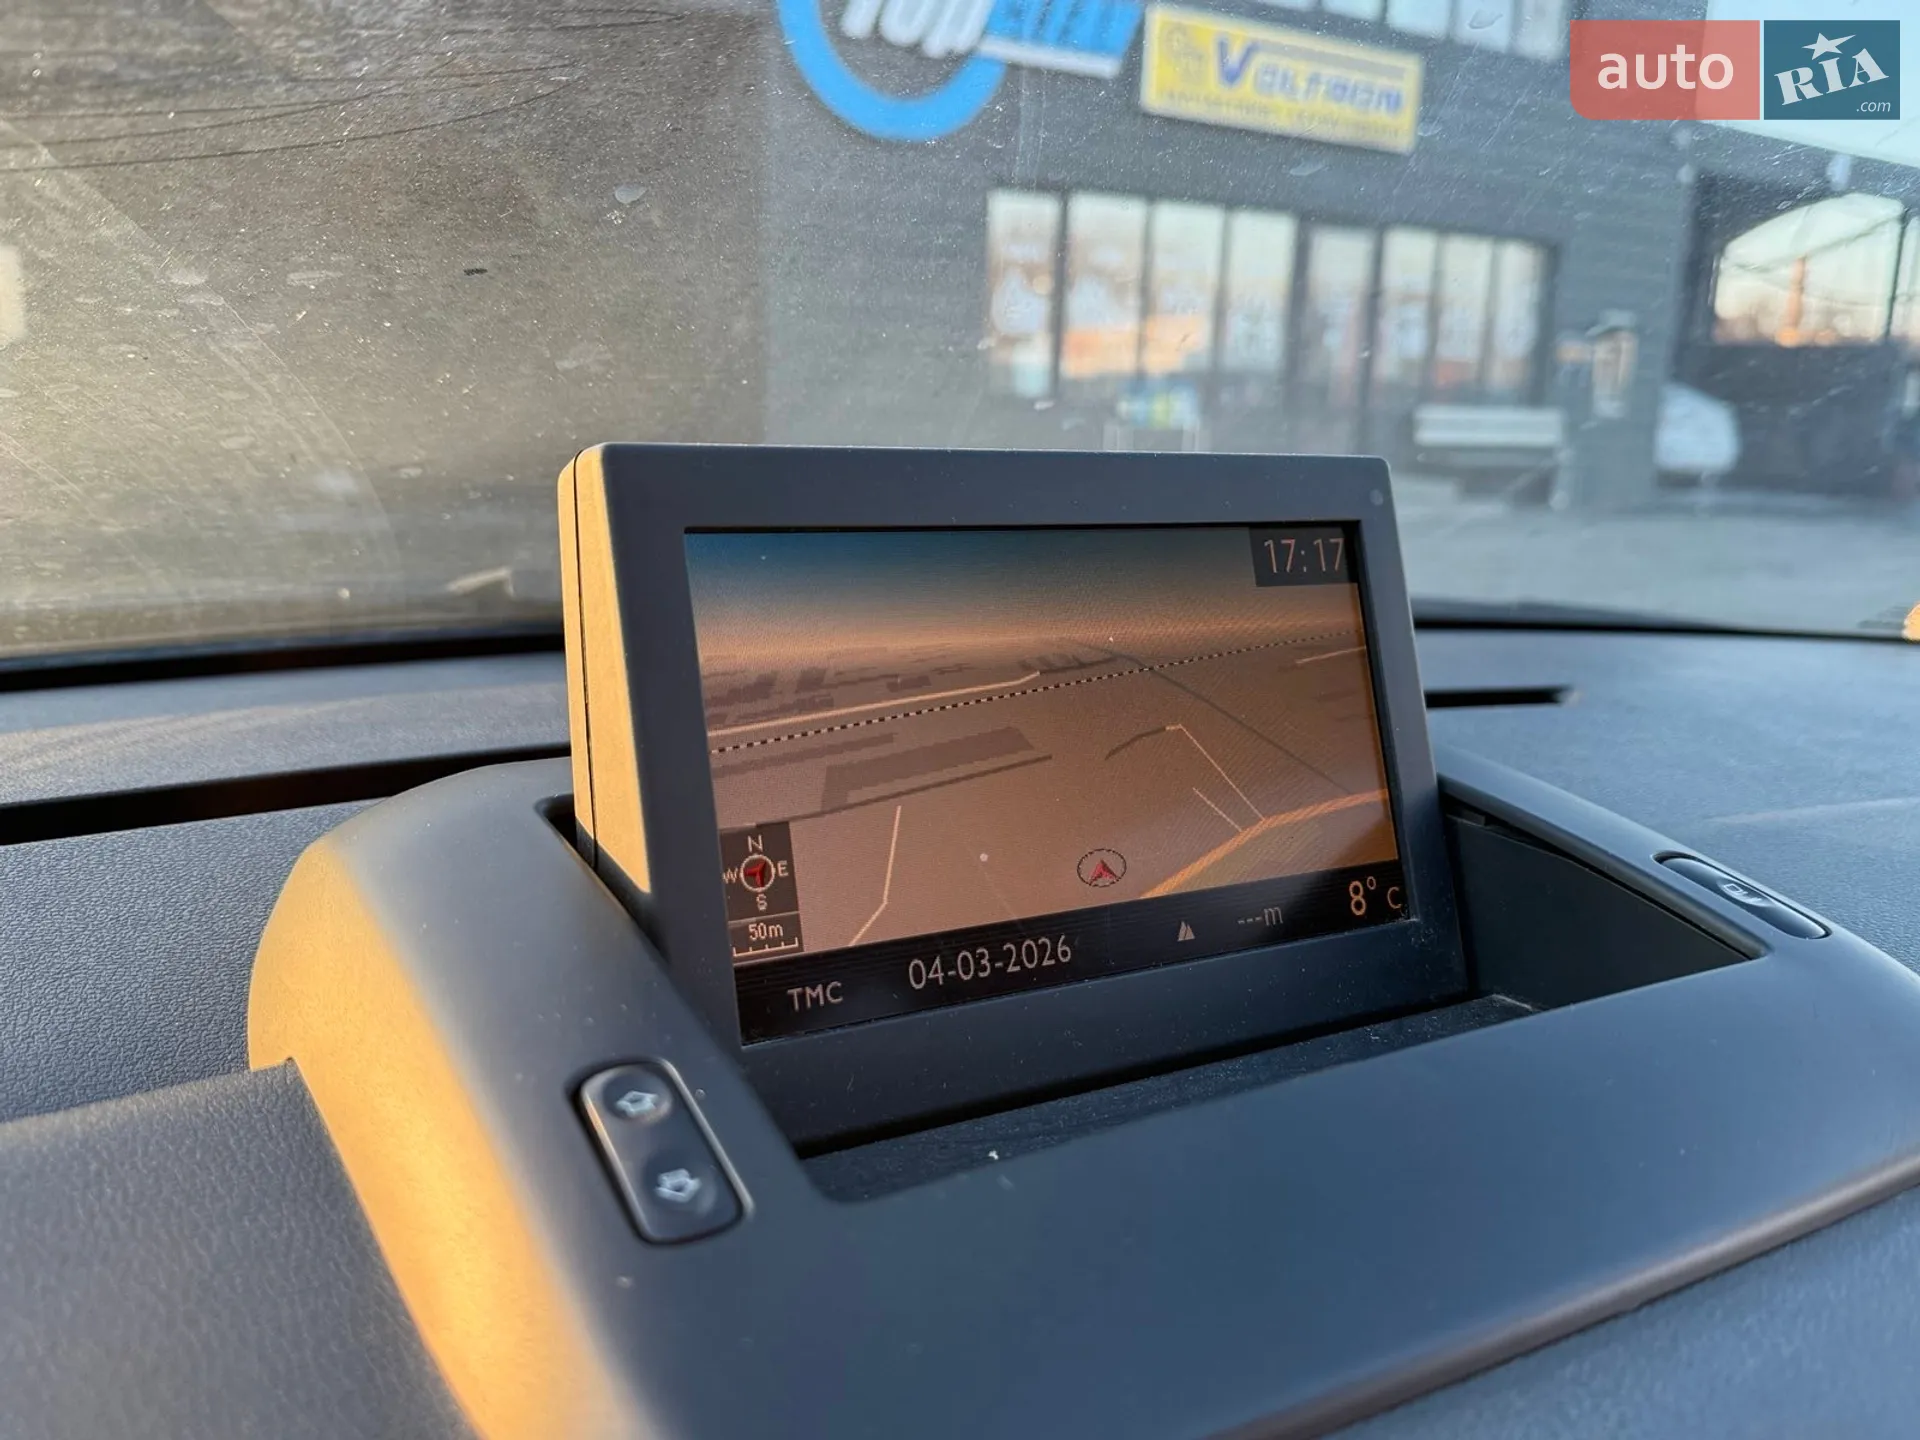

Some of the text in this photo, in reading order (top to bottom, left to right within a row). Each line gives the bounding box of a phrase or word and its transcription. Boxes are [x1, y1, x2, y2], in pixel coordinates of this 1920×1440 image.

[1264, 537, 1345, 574] 17:17
[747, 835, 764, 853] N
[722, 867, 739, 885] W
[776, 859, 790, 877] E
[755, 893, 768, 912] S
[748, 922, 784, 941] 50m
[908, 934, 1073, 991] 04-03-2026
[787, 981, 844, 1012] TMC
